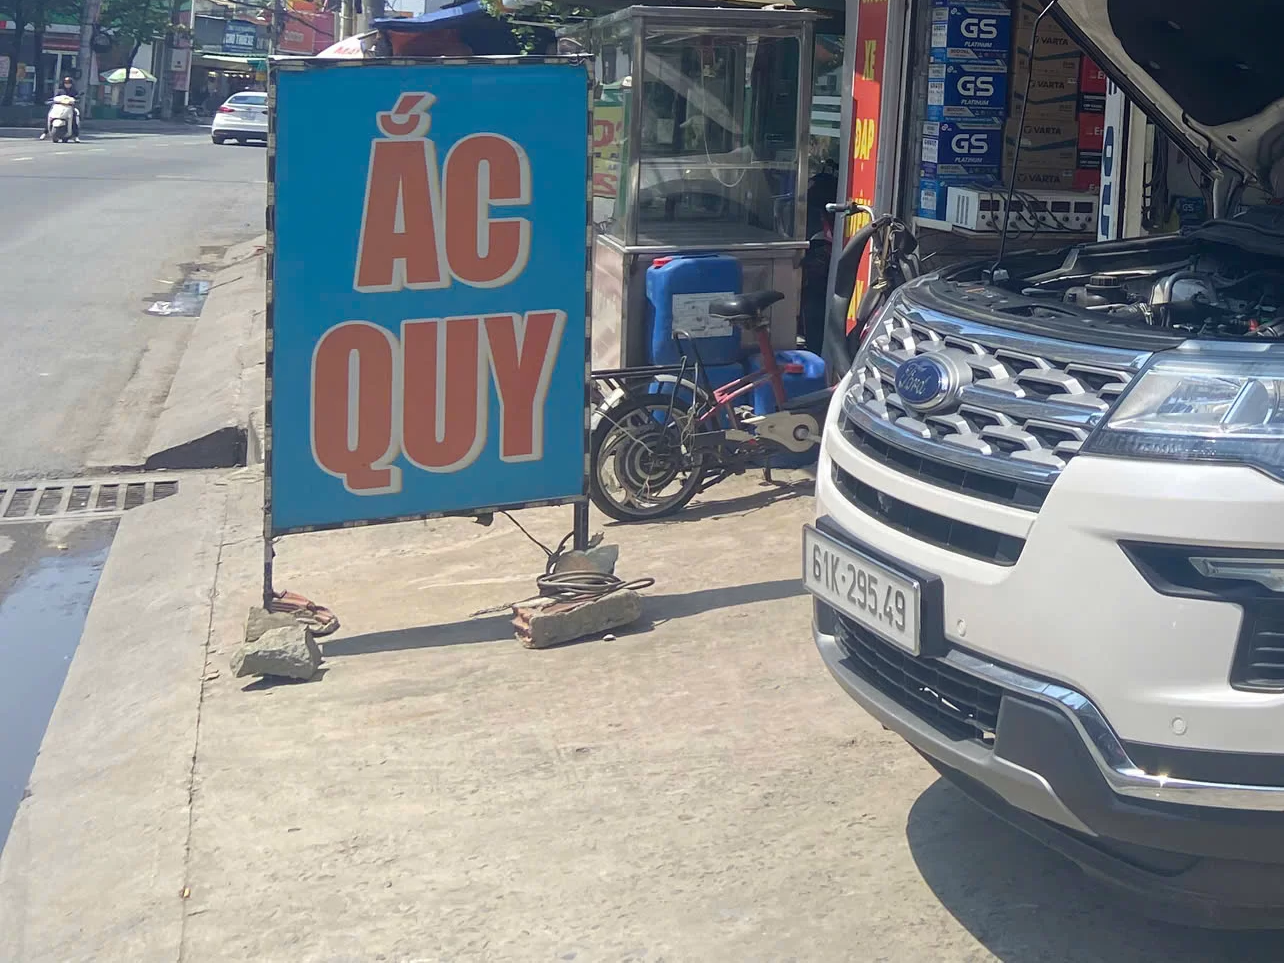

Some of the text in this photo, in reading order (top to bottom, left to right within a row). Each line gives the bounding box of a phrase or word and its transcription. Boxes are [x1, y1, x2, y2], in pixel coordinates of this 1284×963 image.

[960, 18, 998, 39] GS
[1041, 37, 1069, 46] VARTA
[862, 39, 877, 82] XE
[957, 76, 994, 97] GS
[1037, 80, 1065, 89] VARTA
[1033, 126, 1062, 135] VARTA
[951, 134, 988, 154] GS
[1029, 174, 1061, 183] VARTA
[353, 91, 533, 293] ẮC
[899, 362, 932, 395] Ford
[310, 308, 568, 497] QUY
